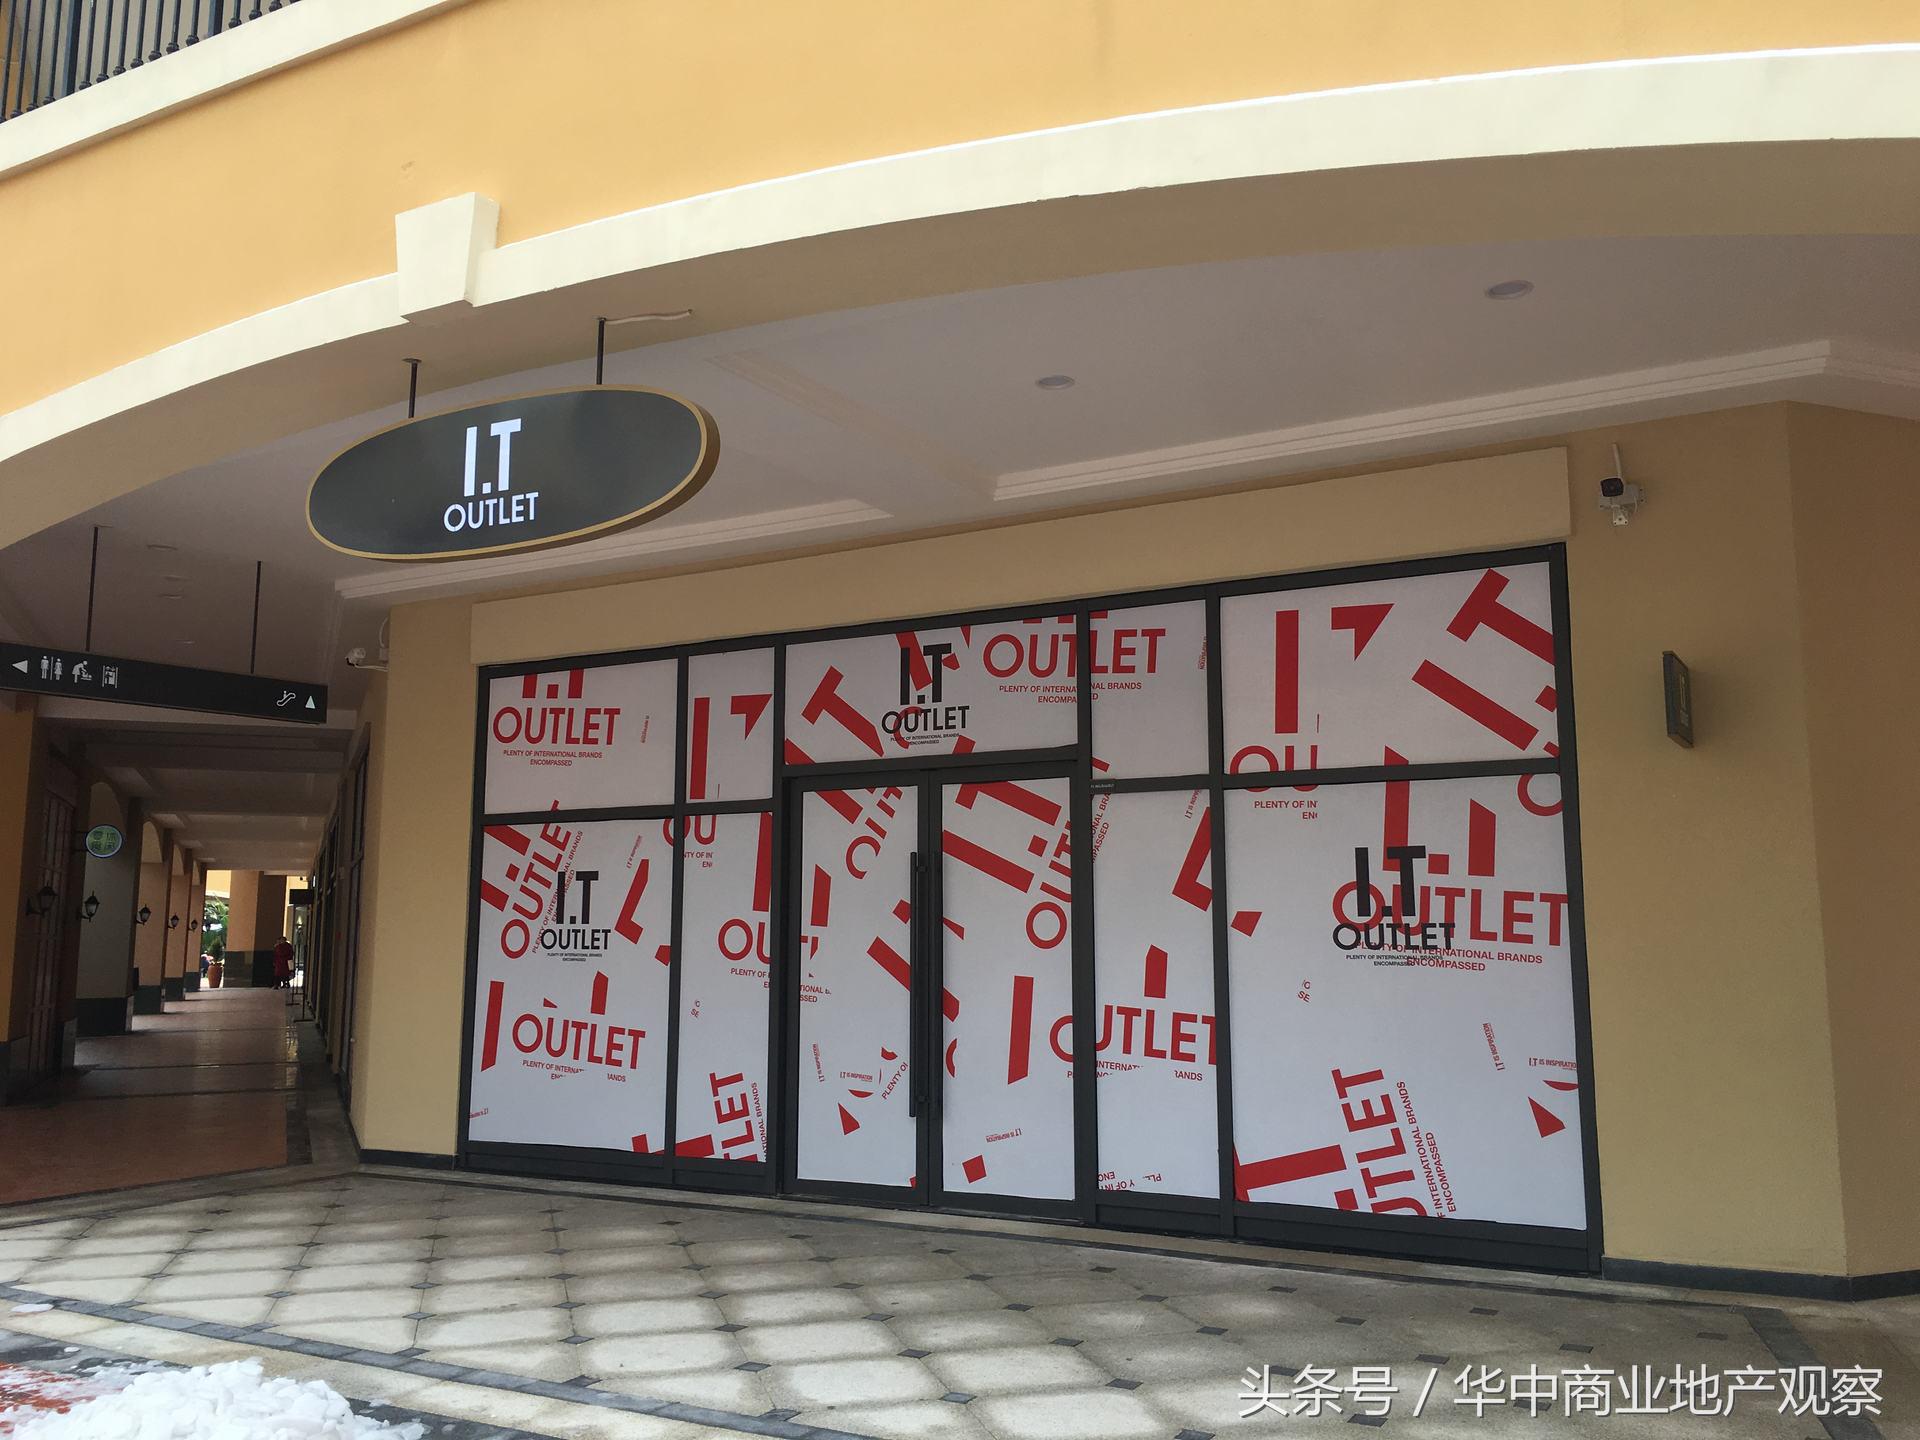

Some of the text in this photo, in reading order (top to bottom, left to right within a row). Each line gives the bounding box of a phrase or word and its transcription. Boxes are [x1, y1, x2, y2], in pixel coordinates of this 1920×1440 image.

[463, 418, 522, 497] I.T
[443, 491, 539, 532] OUTLET
[999, 685, 1029, 693] PLENTY
[1030, 685, 1041, 693] OF
[1107, 682, 1142, 690] BRANDS
[493, 706, 621, 746] OUTLET
[881, 705, 970, 734] OUTLET
[530, 759, 573, 767] ENCOMPASSED
[1254, 800, 1290, 809] PLENTY
[1291, 800, 1305, 809] OF
[1355, 845, 1427, 917] I.T
[556, 871, 599, 925] I.T
[541, 928, 612, 950] OUTLET
[1332, 922, 1456, 951] OUTLET
[1406, 957, 1486, 972] ENCOMPASSED
[1497, 951, 1544, 964] BRANDS
[730, 967, 767, 978] PLENTY OF
[512, 1013, 646, 1070] OUTLET
[522, 1060, 546, 1069] PLENTY
[545, 1063, 556, 1071] OF
[881, 1070, 902, 1100] PLENTY
[1396, 1081, 1417, 1125] BRANDS
[1411, 1126, 1443, 1210] INTERNATIONAL
[1425, 1132, 1457, 1213] ENCOMPASSED
